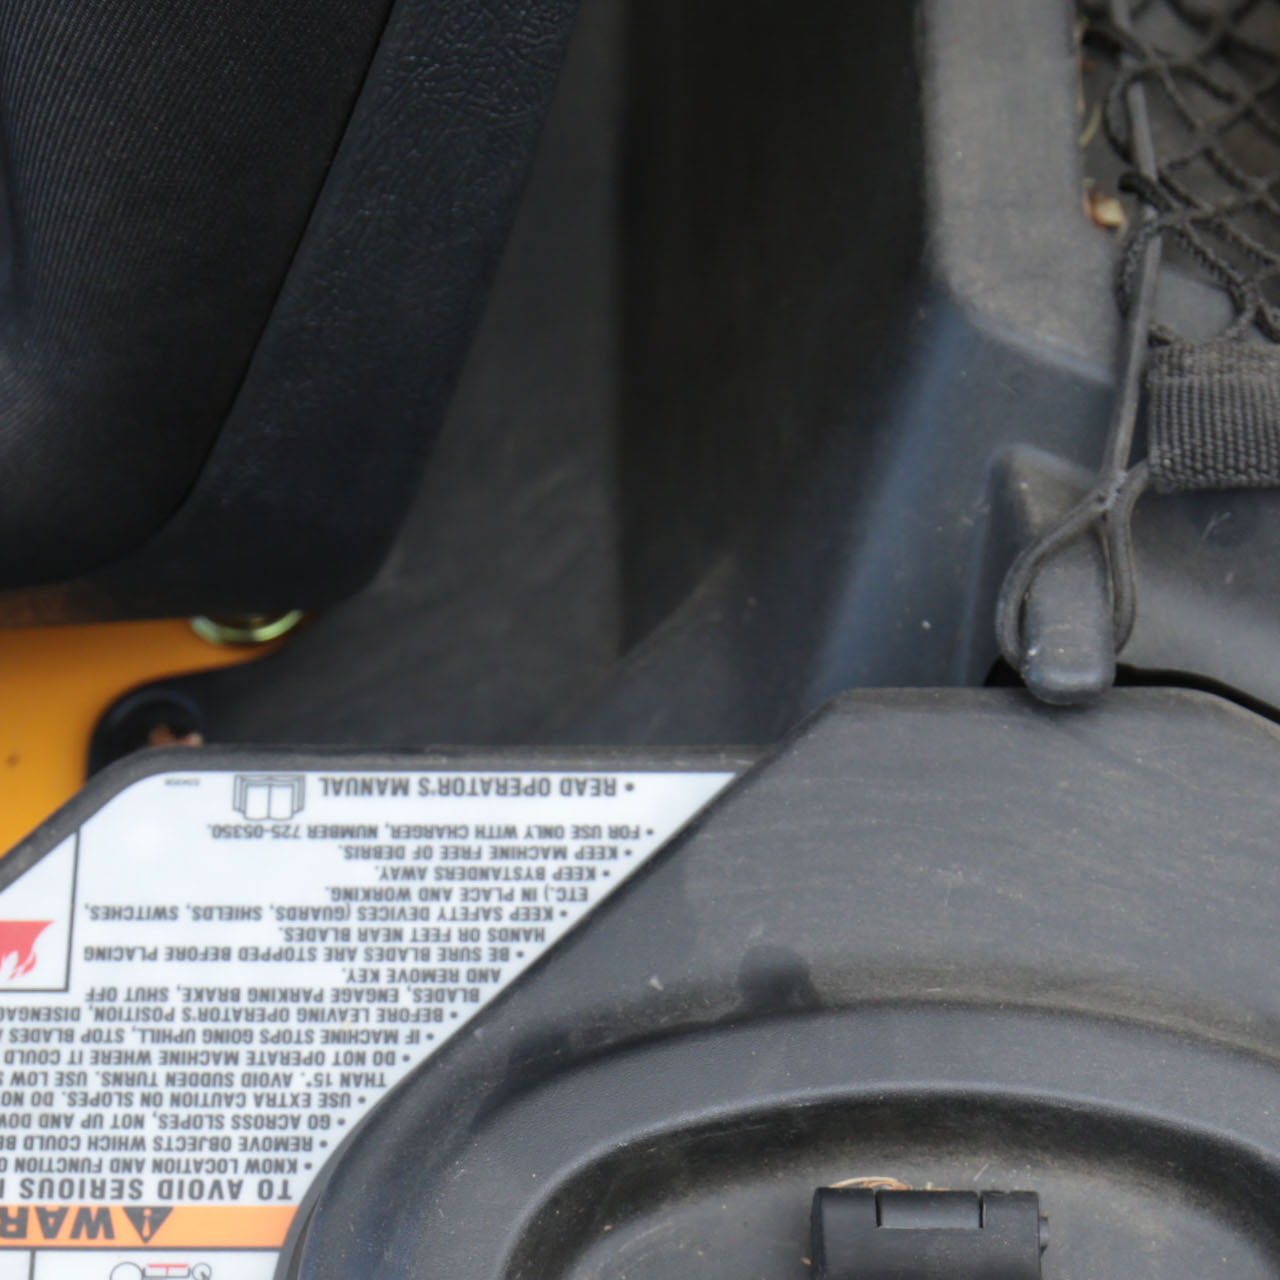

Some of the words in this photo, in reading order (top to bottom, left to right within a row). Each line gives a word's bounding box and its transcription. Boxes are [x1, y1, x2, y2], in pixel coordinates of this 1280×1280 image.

[318, 776, 411, 797] MANUAL
[417, 776, 552, 798] OPERATOR'S
[558, 776, 618, 798] READ
[306, 823, 380, 840] NUMBER
[384, 824, 471, 841] CHARGER,
[473, 824, 519, 841] WITH
[523, 824, 566, 841] ONLY
[571, 824, 604, 841] USE
[607, 824, 642, 841] FOR
[375, 865, 429, 882] AWAY.
[433, 865, 547, 882] BYSTANDERS
[551, 865, 598, 883] KEEP
[278, 926, 352, 943] BLADES.
[356, 926, 404, 944] NEAR
[409, 927, 452, 944] FEET
[457, 927, 482, 944] OR
[486, 926, 547, 944] HANDS
[88, 1005, 176, 1023] POSITION,
[181, 1006, 291, 1024] OPERATOR'S
[295, 1006, 371, 1024] LEAVING
[376, 1006, 445, 1024] BEFORE
[37, 1112, 76, 1130] AND
[79, 1112, 105, 1130] UP
[109, 1113, 146, 1131] NOT
[152, 1112, 226, 1131] SLOPES,
[230, 1113, 303, 1131] ACROSS
[306, 1113, 333, 1132] GO
[22, 1134, 82, 1152] COULD
[86, 1135, 147, 1152] WHICH
[152, 1135, 233, 1153] OBJECTS
[238, 1135, 315, 1153] REMOVE
[13, 1156, 104, 1175] FUNCTION
[108, 1157, 147, 1175] AND
[151, 1157, 240, 1175] LOCATION
[243, 1157, 299, 1175] KNOW
[18, 1177, 145, 1201] SERIOUS
[156, 1178, 245, 1201] AVOID
[256, 1177, 294, 1202] TO
